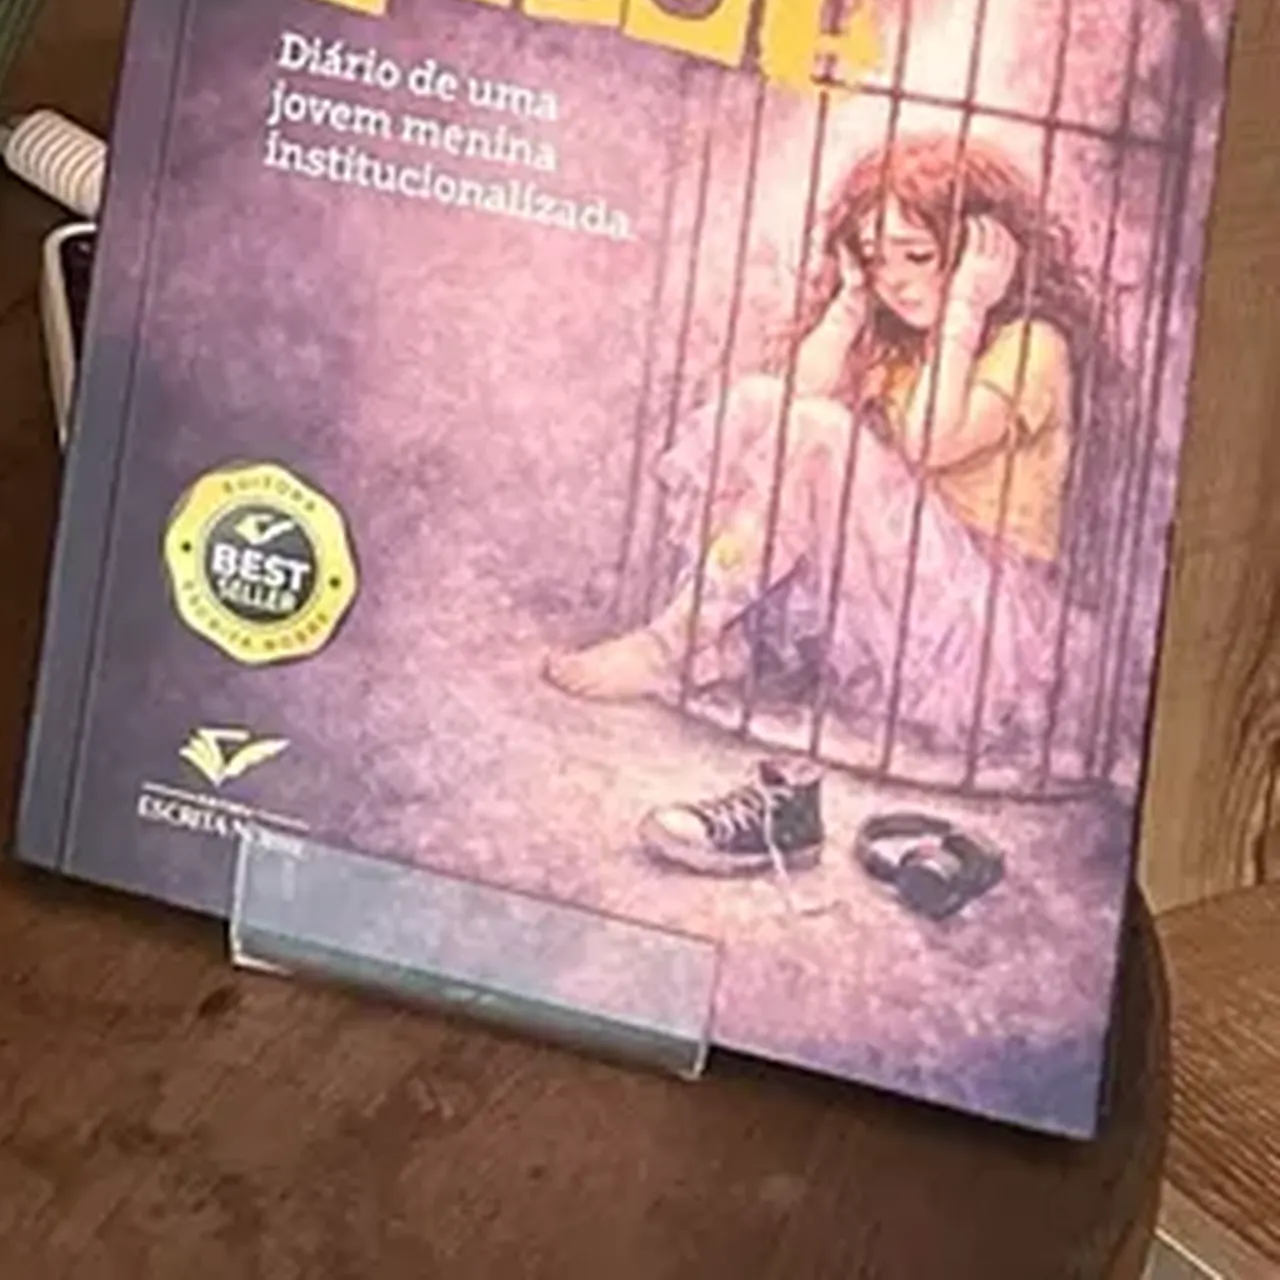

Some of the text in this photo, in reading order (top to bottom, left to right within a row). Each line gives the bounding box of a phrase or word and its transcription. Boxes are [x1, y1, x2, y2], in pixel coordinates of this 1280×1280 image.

[277, 31, 559, 124] Diário de uma
[267, 80, 557, 174] jovem menina
[263, 132, 635, 240] institucionalizada
[211, 542, 311, 592] BEST
